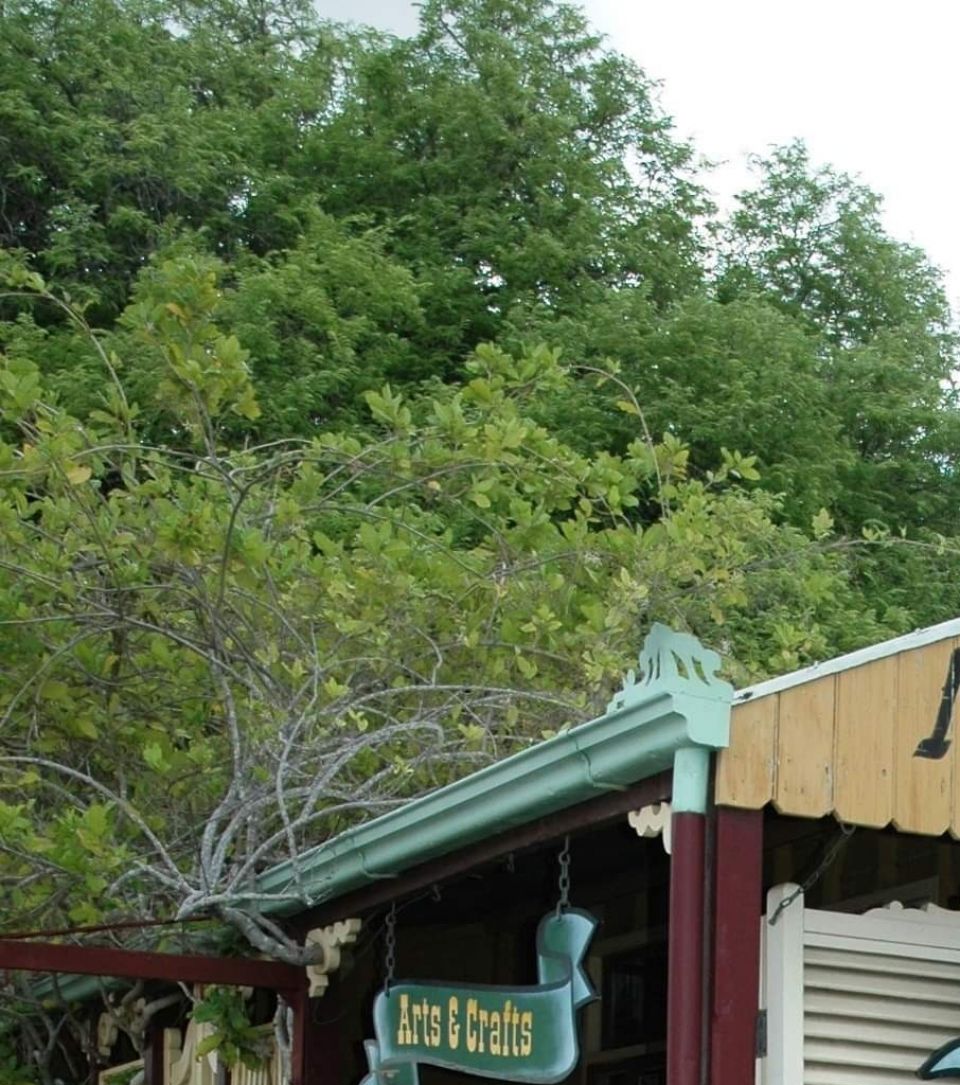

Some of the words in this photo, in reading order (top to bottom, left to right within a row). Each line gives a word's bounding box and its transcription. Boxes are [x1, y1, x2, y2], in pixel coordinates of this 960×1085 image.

[397, 994, 441, 1048] Arts
[448, 996, 460, 1050] &
[466, 998, 533, 1057] Crafts
